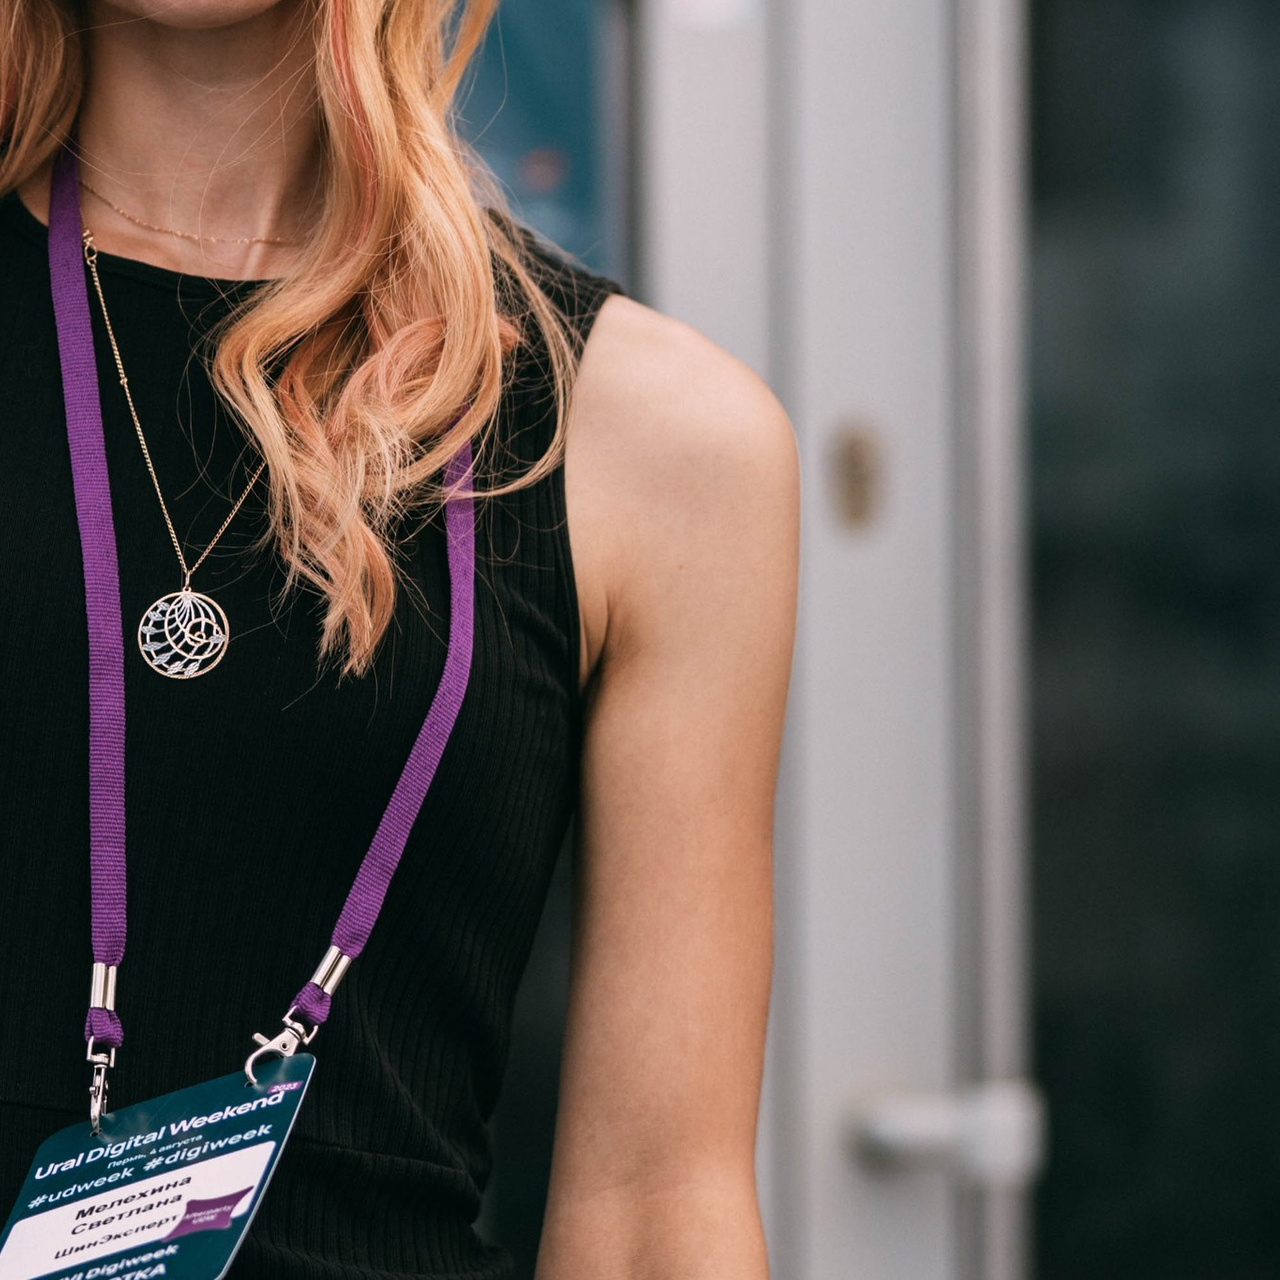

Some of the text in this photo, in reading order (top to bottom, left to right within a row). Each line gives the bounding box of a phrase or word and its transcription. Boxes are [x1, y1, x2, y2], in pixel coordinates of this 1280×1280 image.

[35, 1090, 285, 1180] Ural Digital Weekend
[158, 1135, 203, 1153] августа
[28, 1124, 272, 1209] #udweek #digiweek
[71, 1194, 182, 1235] Светлана
[75, 1176, 192, 1220] Мелехина
[54, 1214, 179, 1260] ШинЭксперт
[85, 1244, 179, 1280] Digiweek
